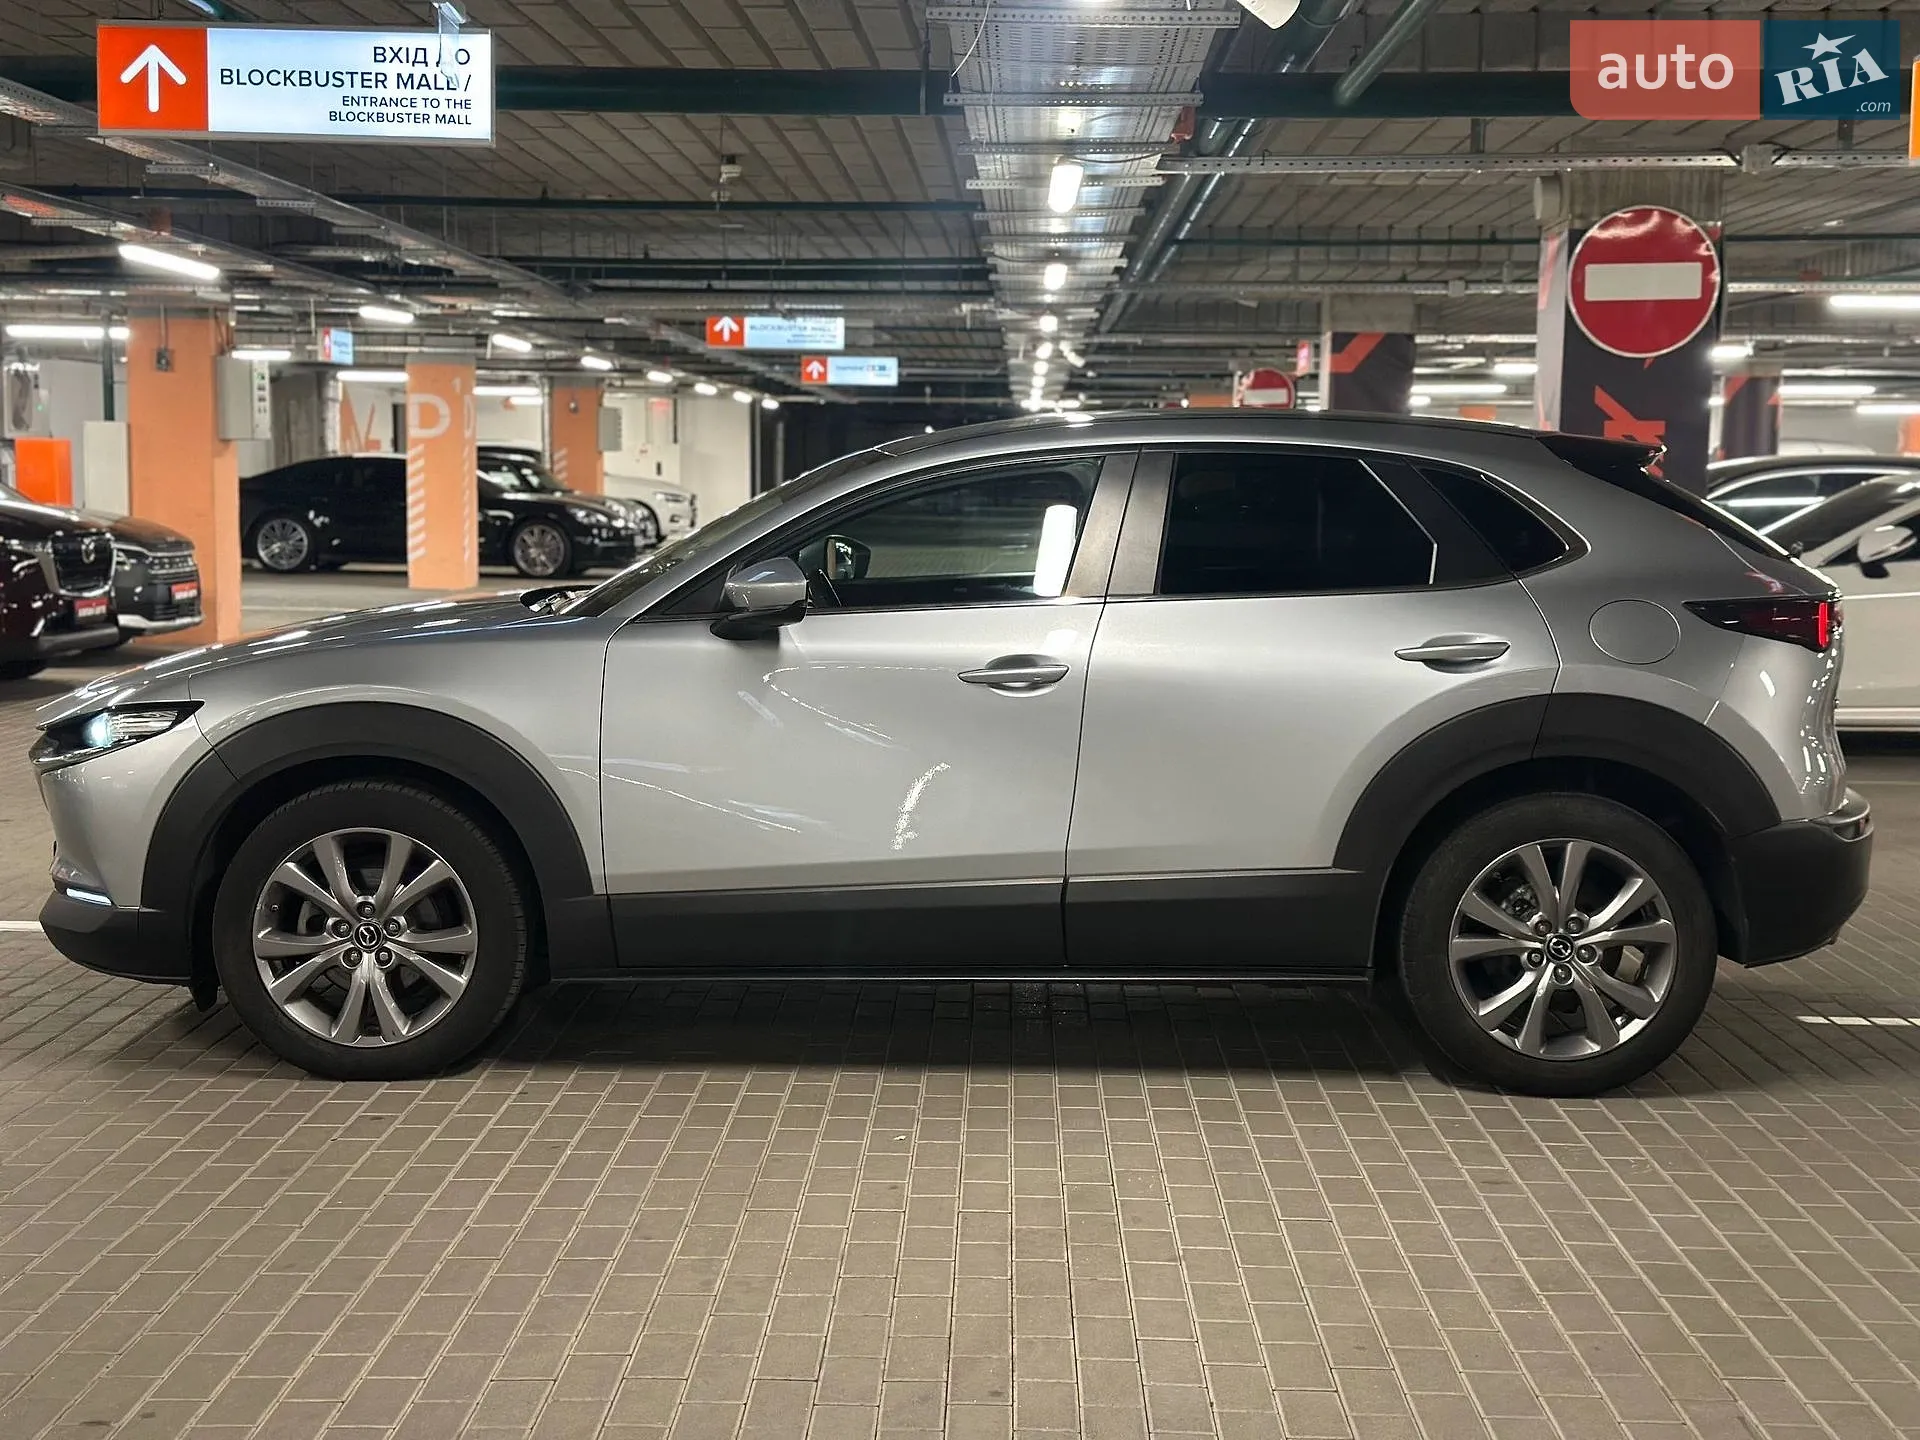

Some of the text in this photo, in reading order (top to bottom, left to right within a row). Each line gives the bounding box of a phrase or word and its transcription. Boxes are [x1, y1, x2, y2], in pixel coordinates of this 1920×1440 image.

[373, 46, 471, 67] ВХІД О
[220, 68, 388, 89] BLOCKBUSTER
[396, 72, 457, 90] MALL
[342, 95, 472, 109] ENTRANCE TO THE
[328, 110, 472, 125] BLOCKBUSTER MALL
